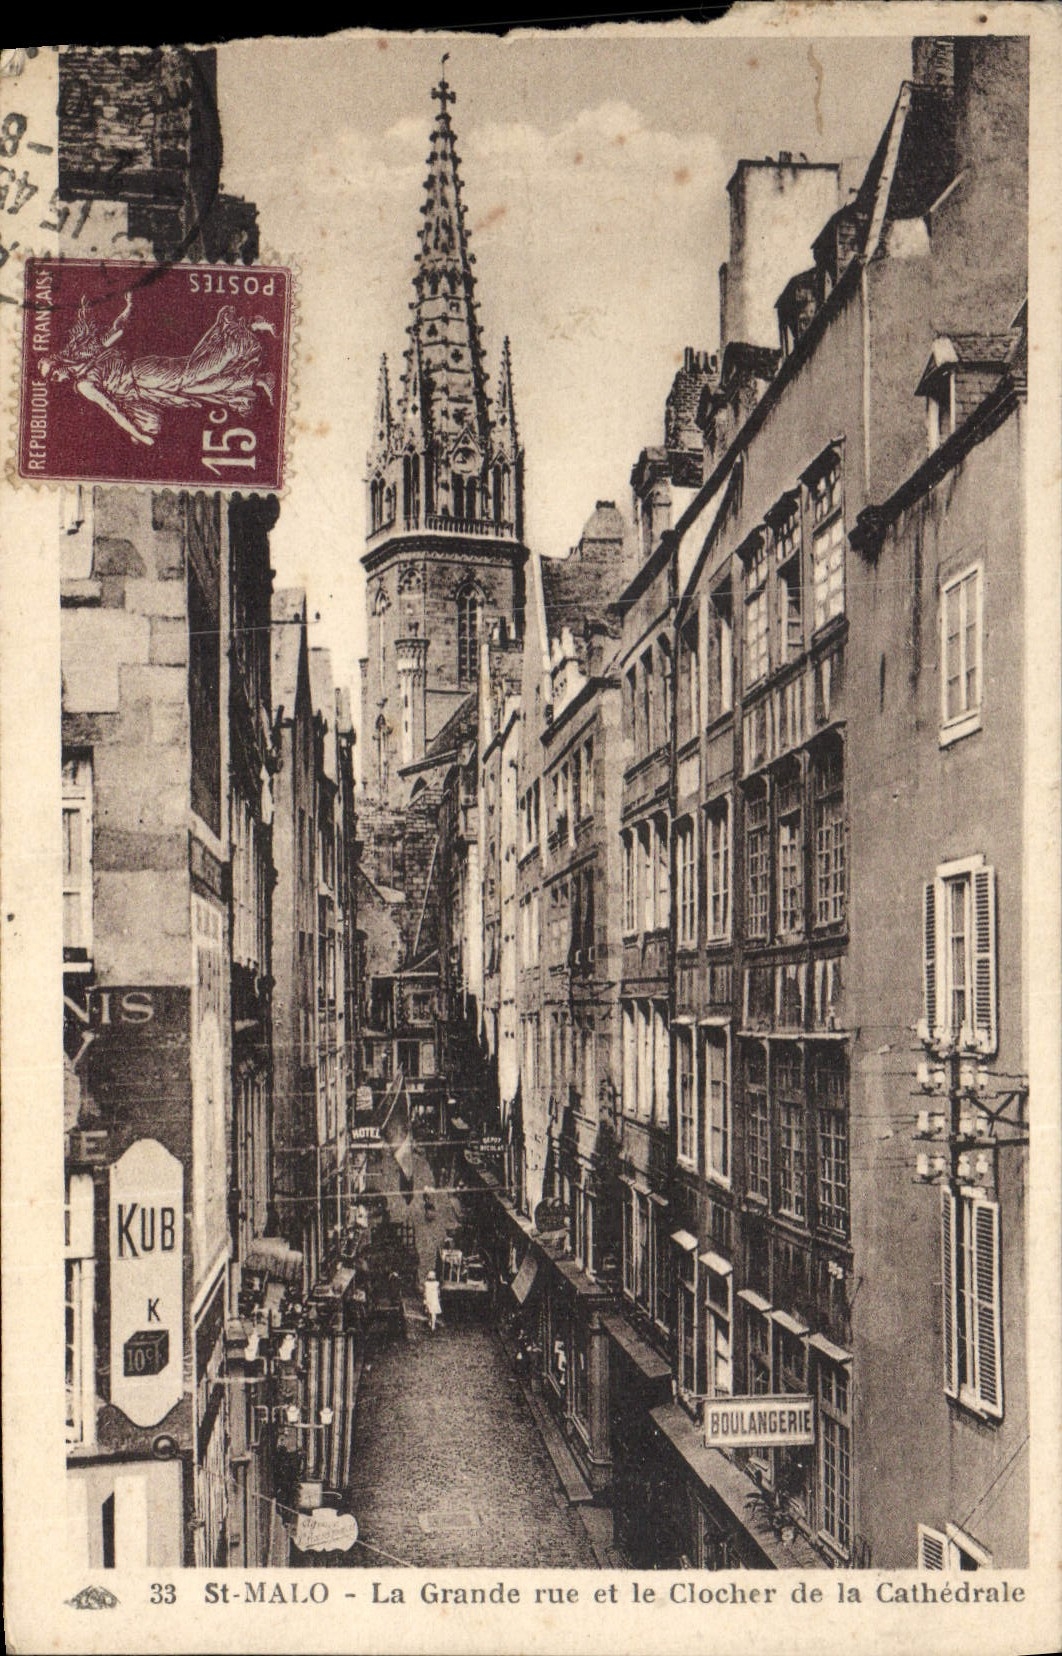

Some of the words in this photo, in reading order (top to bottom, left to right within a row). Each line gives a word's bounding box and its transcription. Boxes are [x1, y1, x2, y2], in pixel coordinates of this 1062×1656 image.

[189, 273, 275, 296] POSTES
[117, 1203, 176, 1258] KUB
[148, 1297, 161, 1322] K
[710, 1410, 812, 1435] BOULANGERIE
